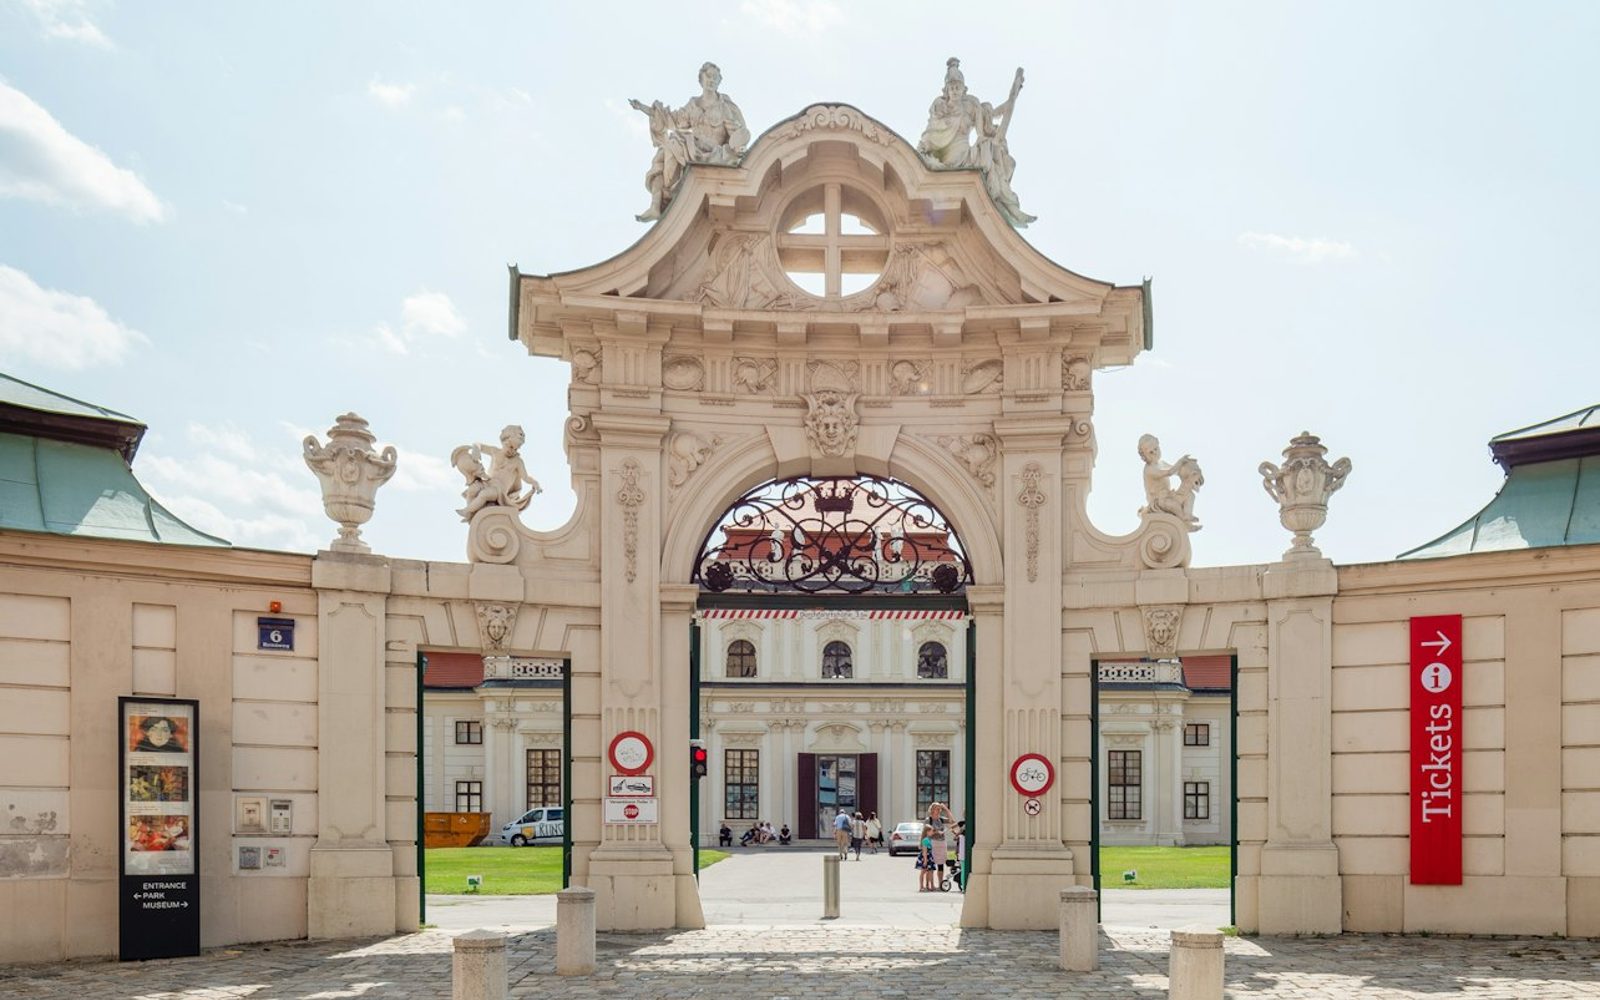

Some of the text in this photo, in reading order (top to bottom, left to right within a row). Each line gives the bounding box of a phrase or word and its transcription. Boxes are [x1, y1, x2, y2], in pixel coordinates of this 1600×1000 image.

[270, 630, 283, 643] 6
[1421, 703, 1453, 823] Tickets
[142, 881, 187, 890] ENTRANCE
[142, 892, 166, 900] PARK
[142, 901, 180, 909] MUSEUM
